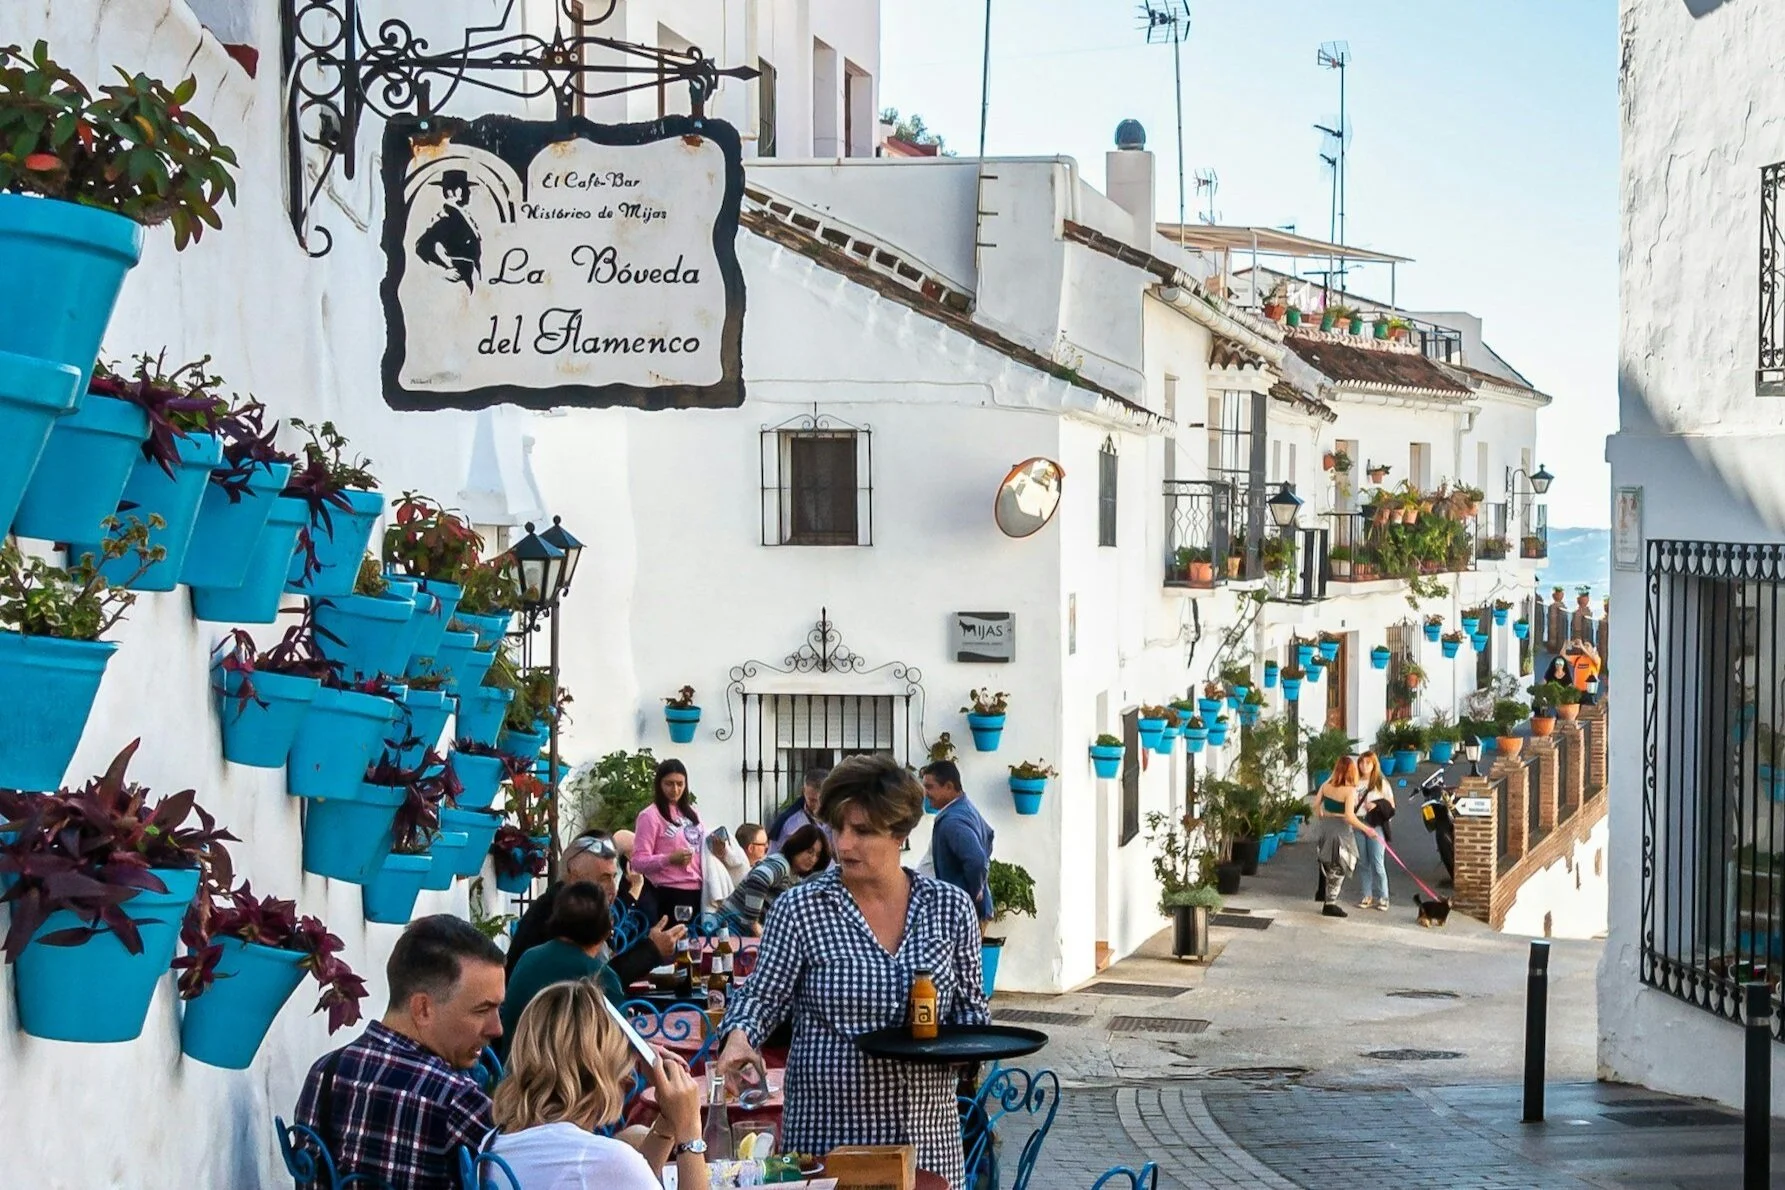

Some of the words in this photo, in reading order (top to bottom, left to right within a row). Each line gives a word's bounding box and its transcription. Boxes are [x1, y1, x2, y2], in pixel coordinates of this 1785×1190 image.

[542, 172, 560, 189] El
[564, 170, 641, 192] Café-Bar
[521, 203, 591, 220] Histórico
[598, 205, 614, 220] de
[618, 202, 667, 224] Mijas
[488, 247, 545, 285] La
[571, 244, 700, 285] Bóveda
[478, 314, 522, 355] del
[533, 307, 701, 355] Flamenco
